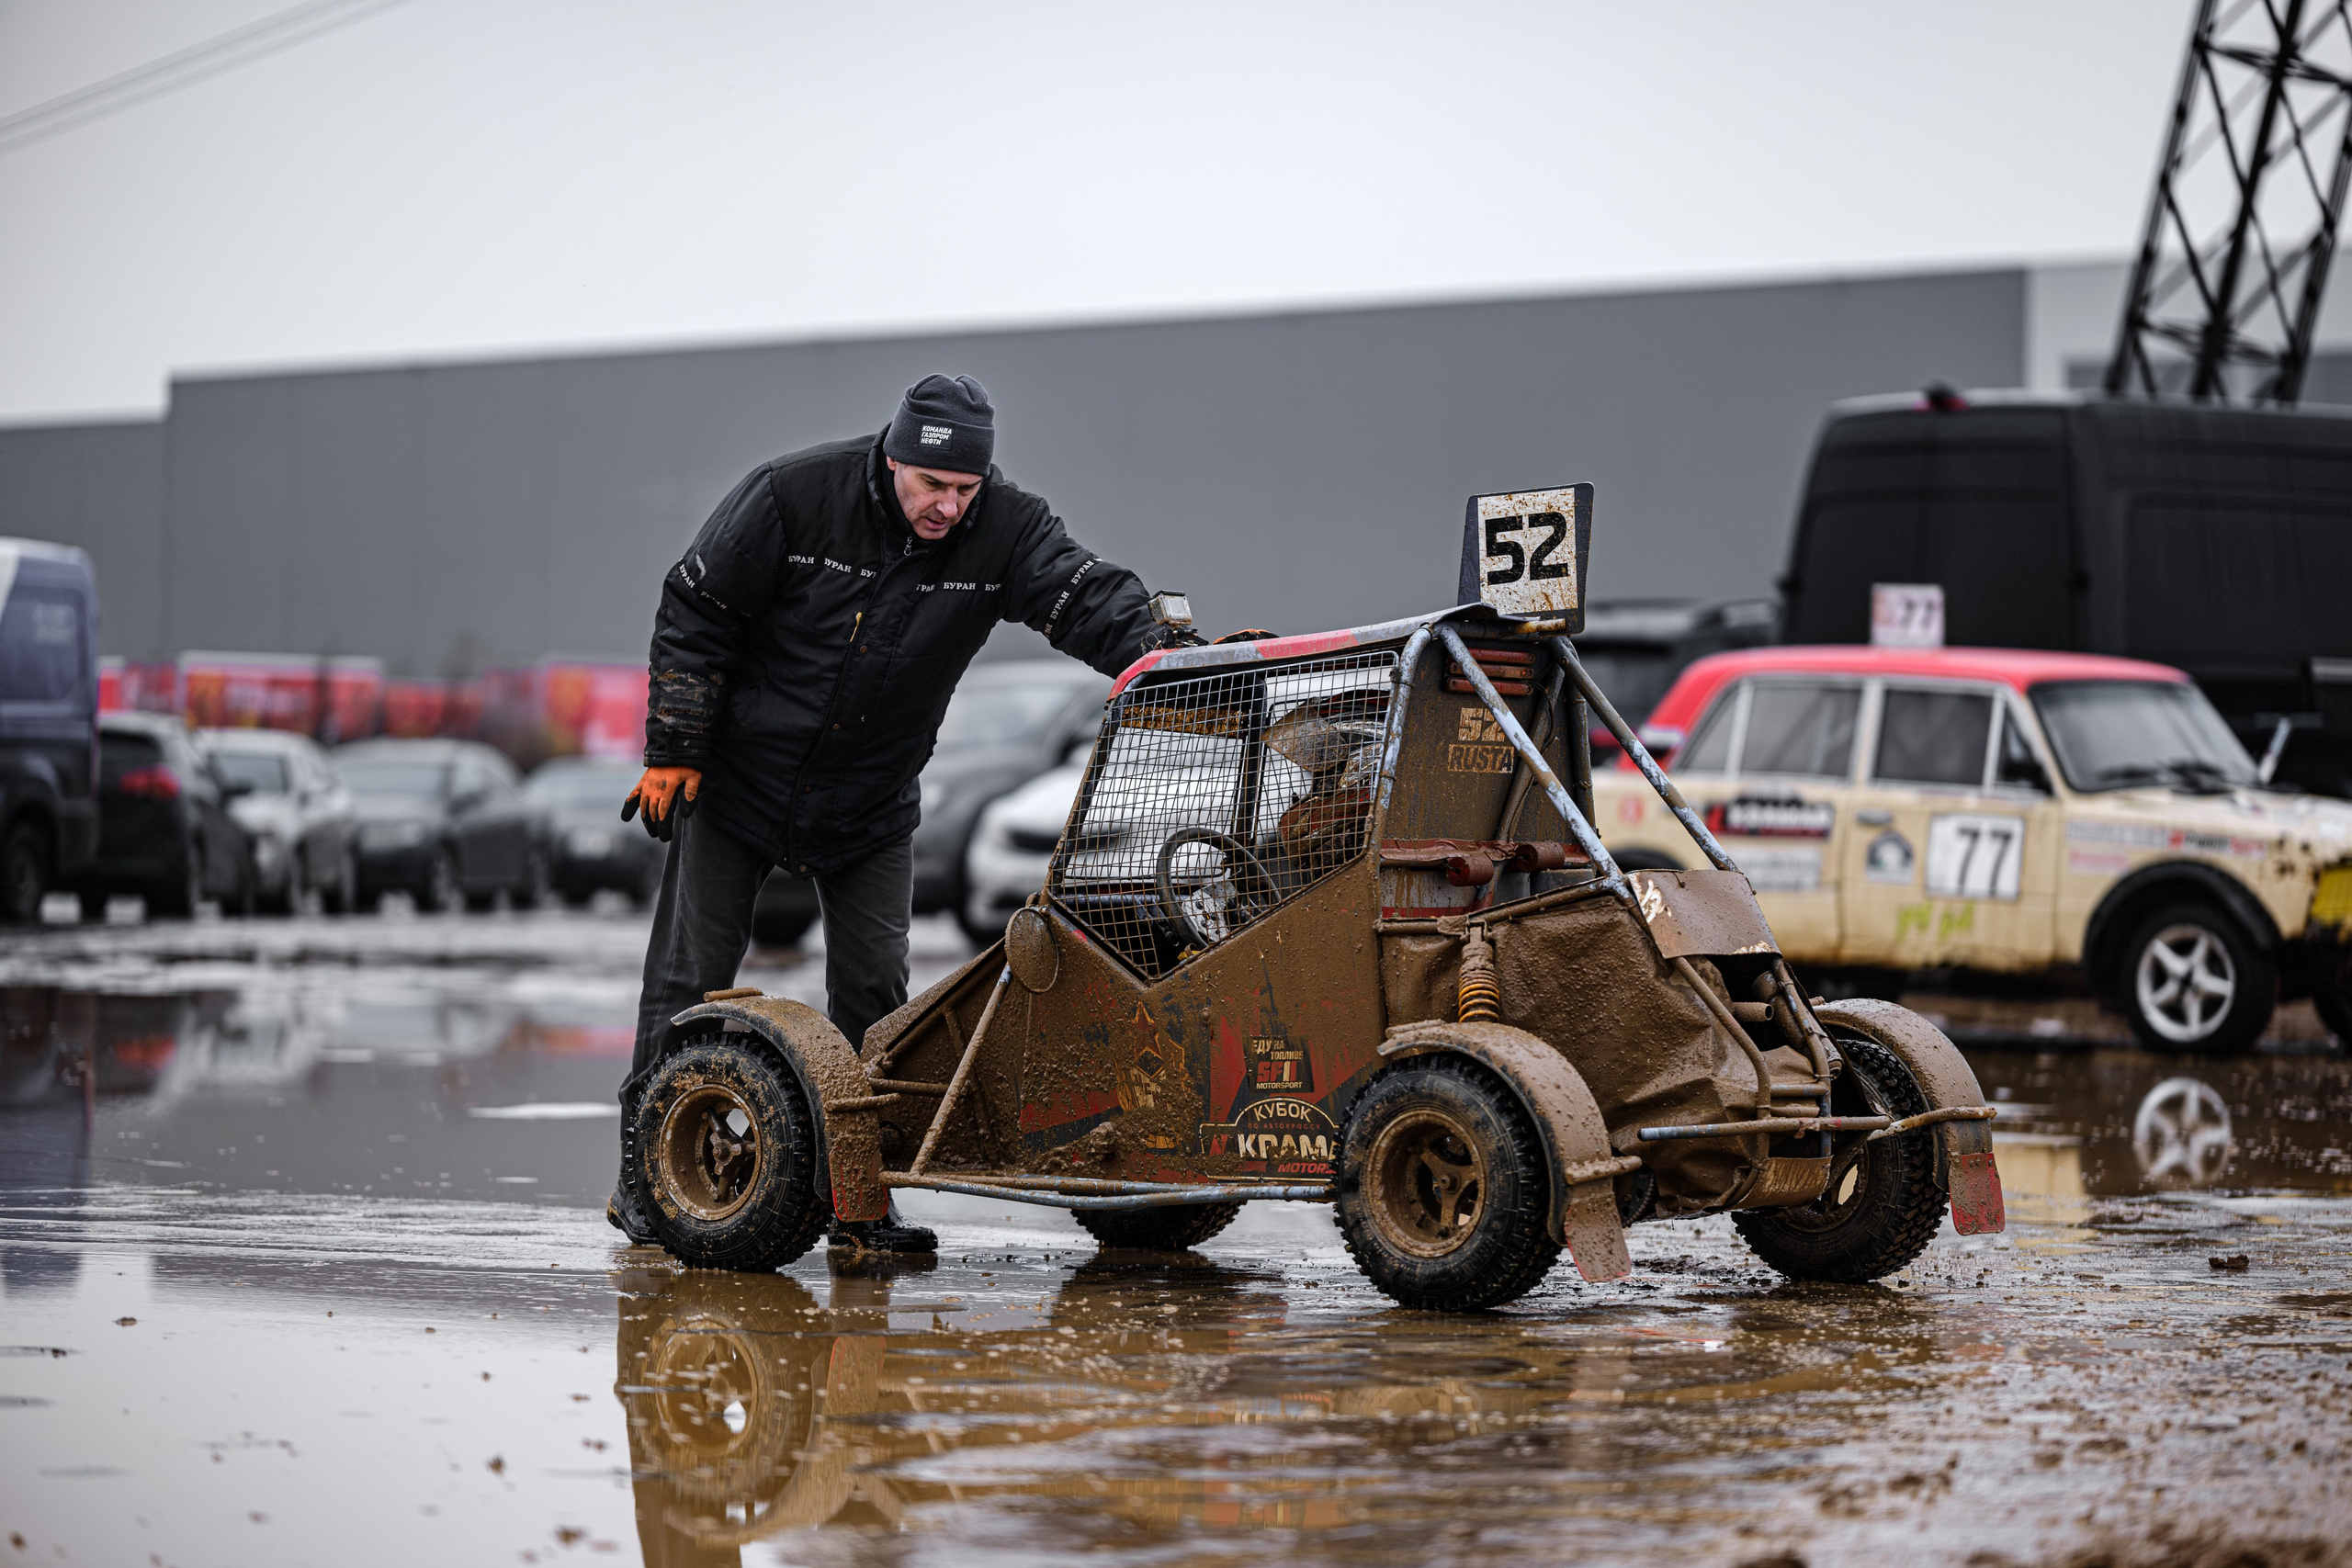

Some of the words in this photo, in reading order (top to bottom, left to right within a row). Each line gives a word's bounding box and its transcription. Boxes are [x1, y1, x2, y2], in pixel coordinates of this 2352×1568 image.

[921, 432, 950, 440] ГАЗПРОМ
[922, 425, 952, 434] КОМАНДА
[921, 437, 942, 446] НЕФТИ
[1485, 512, 1570, 586] 52
[788, 555, 815, 564] БУРАН
[943, 581, 976, 591] БУРАН
[1049, 591, 1070, 620] БУРАН
[1070, 560, 1094, 585] БУРАН
[1458, 707, 1506, 742] 52
[1450, 746, 1513, 772] RUSTA
[1957, 826, 2014, 897] 77
[1252, 1039, 1272, 1055] ЕДУ
[1273, 1040, 1285, 1050] НА
[1271, 1050, 1304, 1060] ТОПЛИВЕ
[1253, 1102, 1312, 1122] КУБОК
